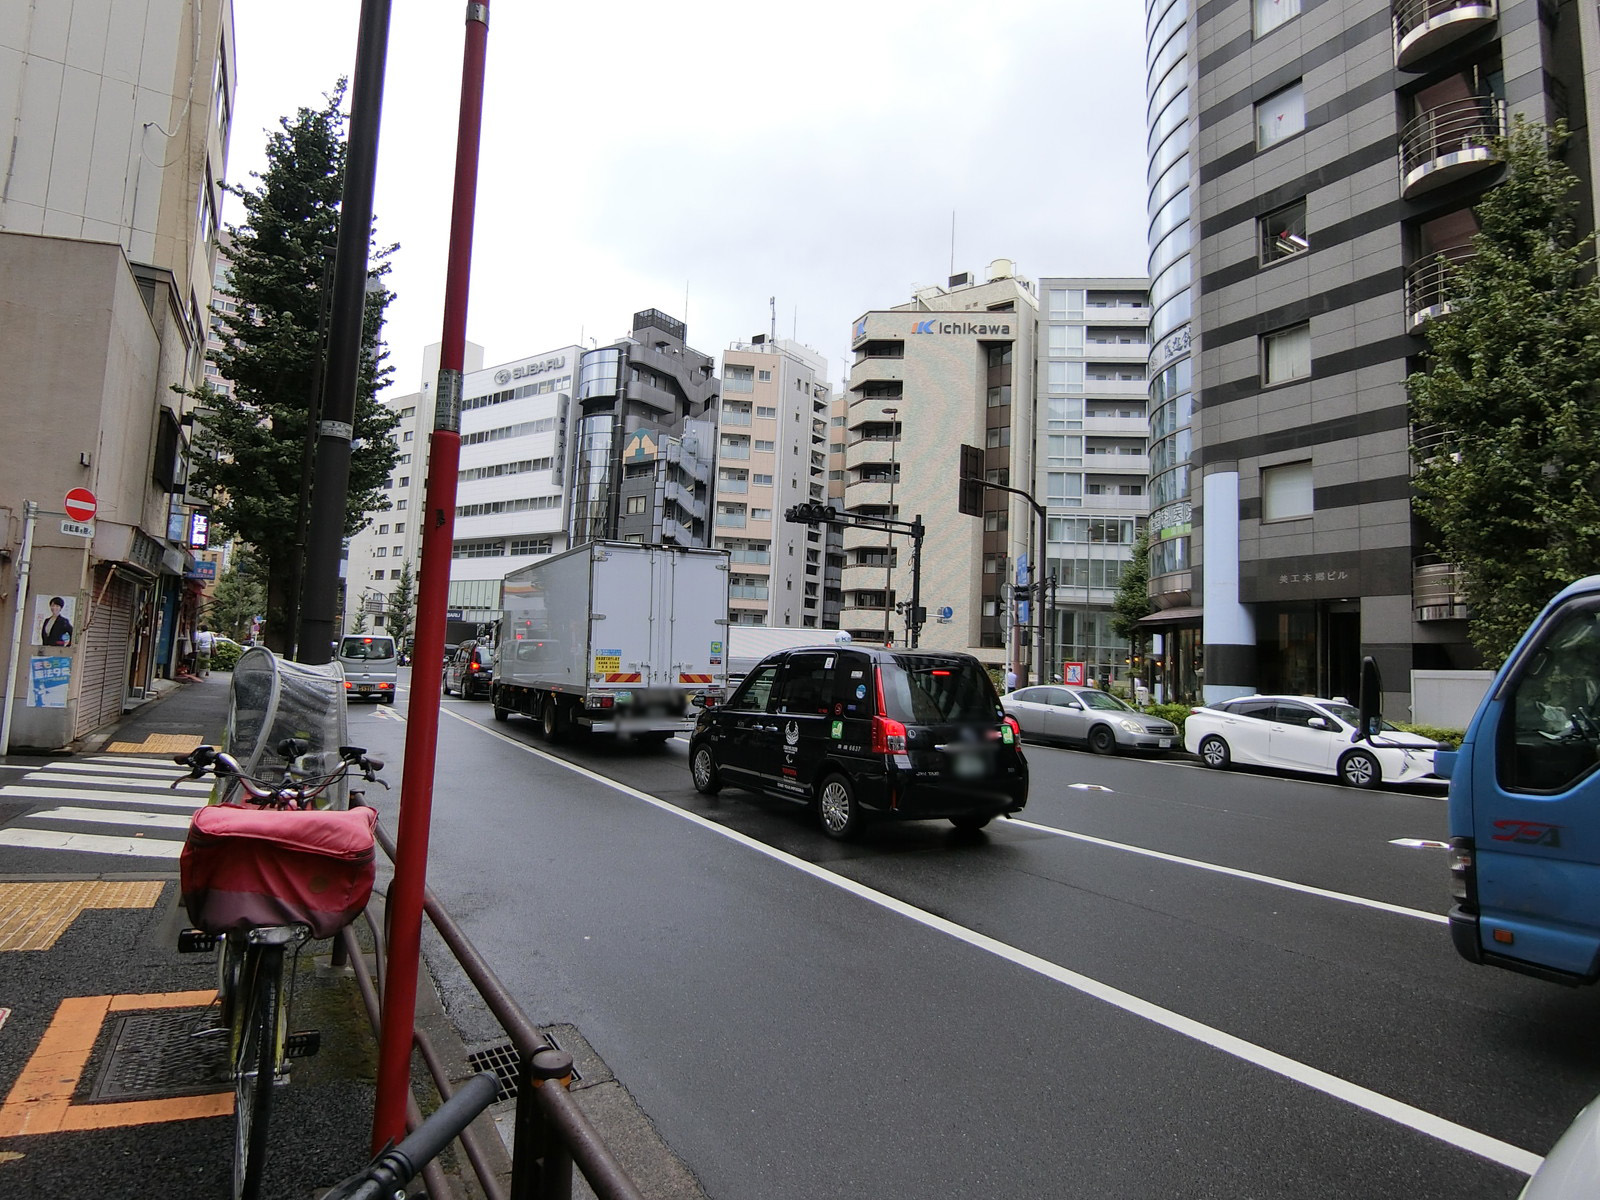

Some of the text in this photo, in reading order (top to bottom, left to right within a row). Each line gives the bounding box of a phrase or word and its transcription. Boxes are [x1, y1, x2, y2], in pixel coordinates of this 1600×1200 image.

[939, 322, 1010, 335] Ichikawa
[512, 356, 565, 380] SUBARU
[1279, 571, 1348, 584] 美工本郷ビル
